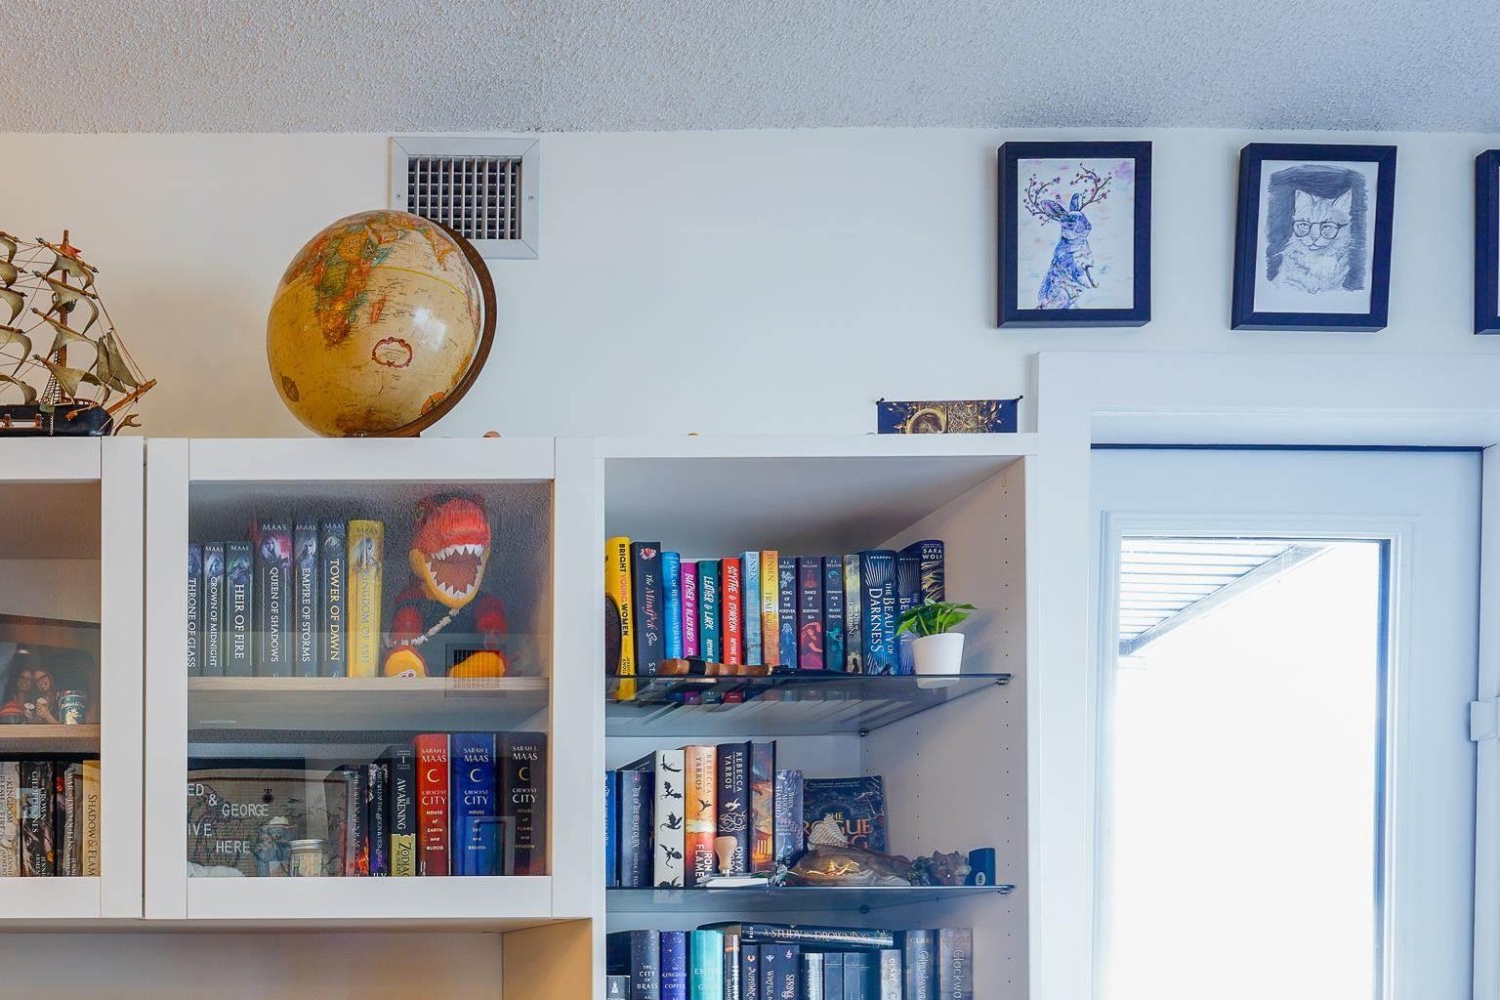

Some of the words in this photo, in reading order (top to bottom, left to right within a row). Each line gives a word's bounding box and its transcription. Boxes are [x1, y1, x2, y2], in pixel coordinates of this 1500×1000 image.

[270, 567, 279, 600] QUEEN
[302, 568, 311, 601] EMPIRE
[330, 558, 340, 603] TOWER
[704, 576, 714, 602] LEATHER
[727, 566, 739, 593] SCYTHE
[210, 576, 218, 608] CROWN
[234, 584, 244, 612] HEIR
[210, 609, 217, 622] OF
[270, 603, 279, 614] OF
[302, 604, 311, 620] OF
[330, 605, 340, 621] OF
[705, 611, 714, 630] LARK
[728, 602, 738, 633] SPARROW
[869, 588, 884, 652] DARKNESS
[883, 597, 895, 644] BEAUTY
[234, 614, 244, 632] OF
[234, 635, 244, 659] FIRE
[270, 615, 279, 662] SHADOWS
[302, 622, 311, 662] STORMS
[330, 624, 340, 661] DAWN
[888, 644, 894, 654] OF
[421, 754, 447, 763] MAAS
[464, 754, 489, 763] MAAS
[512, 752, 538, 761] MAAS
[208, 794, 218, 806] &
[222, 803, 269, 816] GEORGE
[397, 778, 406, 830] AWAKENING
[421, 796, 447, 805] CITY
[464, 796, 490, 805] CITY
[512, 794, 536, 803] CITY
[88, 795, 97, 838] SHADOW
[88, 840, 96, 848] &
[216, 840, 250, 853] HERE
[88, 849, 97, 877] FLAM
[695, 844, 704, 877] FLAME
[704, 848, 713, 872] IRON
